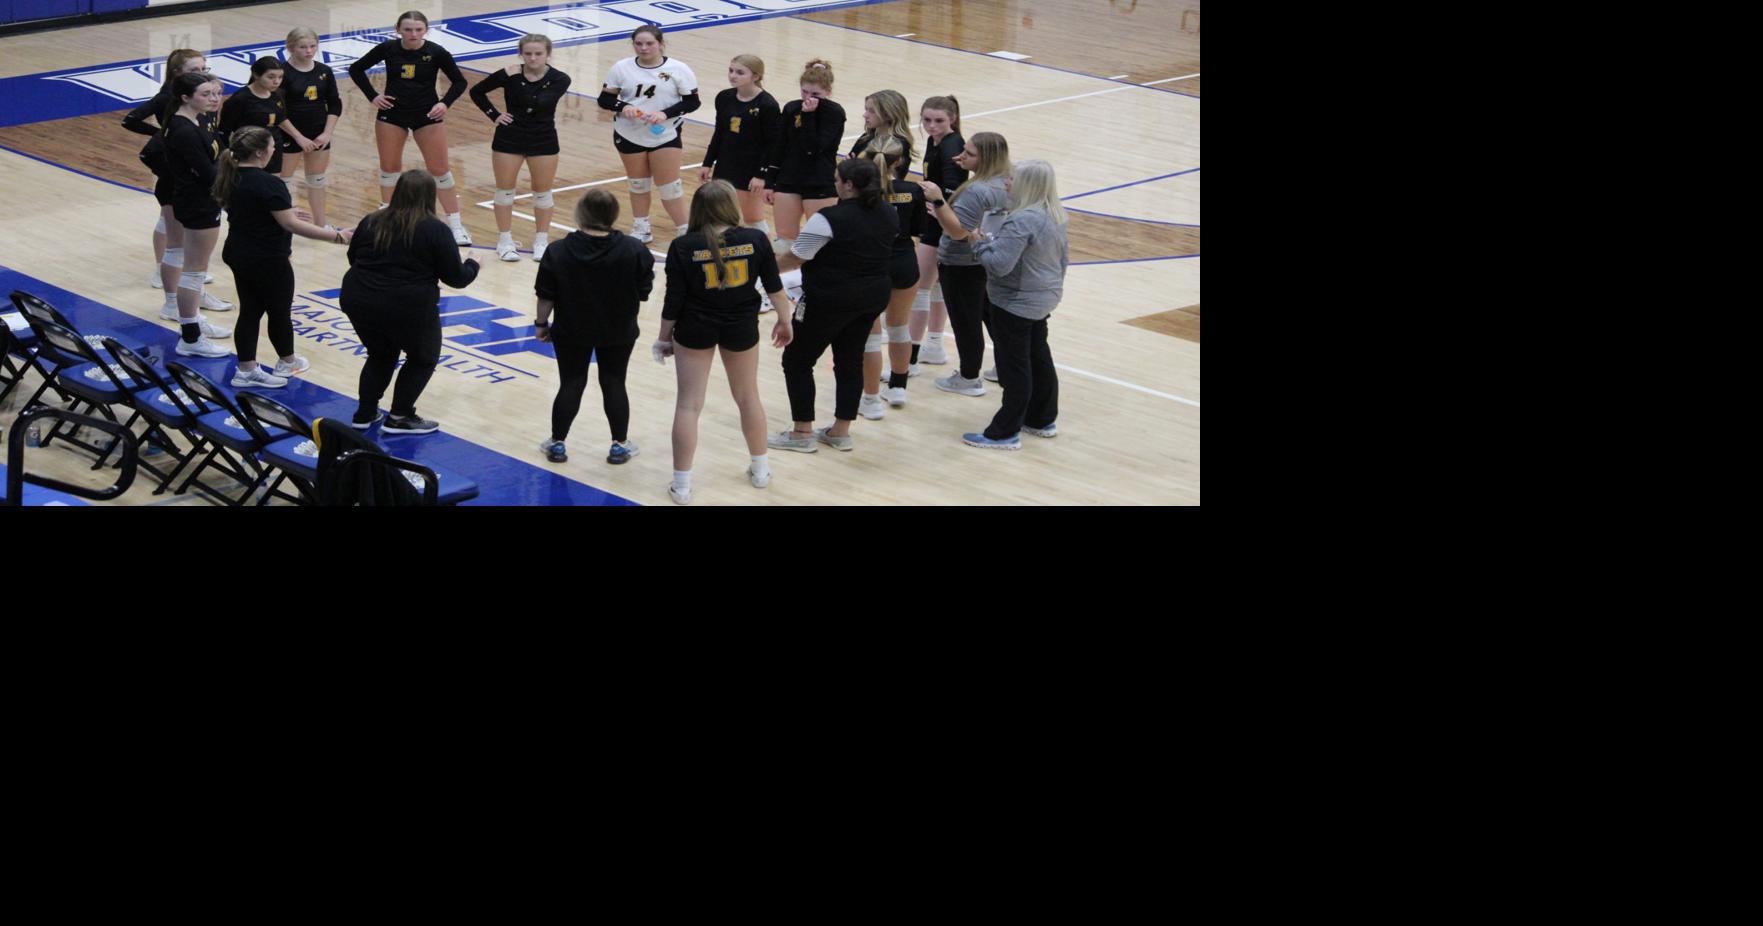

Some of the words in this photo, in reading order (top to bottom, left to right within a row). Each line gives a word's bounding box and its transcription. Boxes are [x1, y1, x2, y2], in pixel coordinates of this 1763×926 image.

[401, 64, 415, 79] 3
[304, 85, 318, 100] 4
[635, 84, 656, 98] 14
[730, 116, 741, 134] 2
[692, 243, 754, 262] JAKETS
[702, 259, 748, 290] 10
